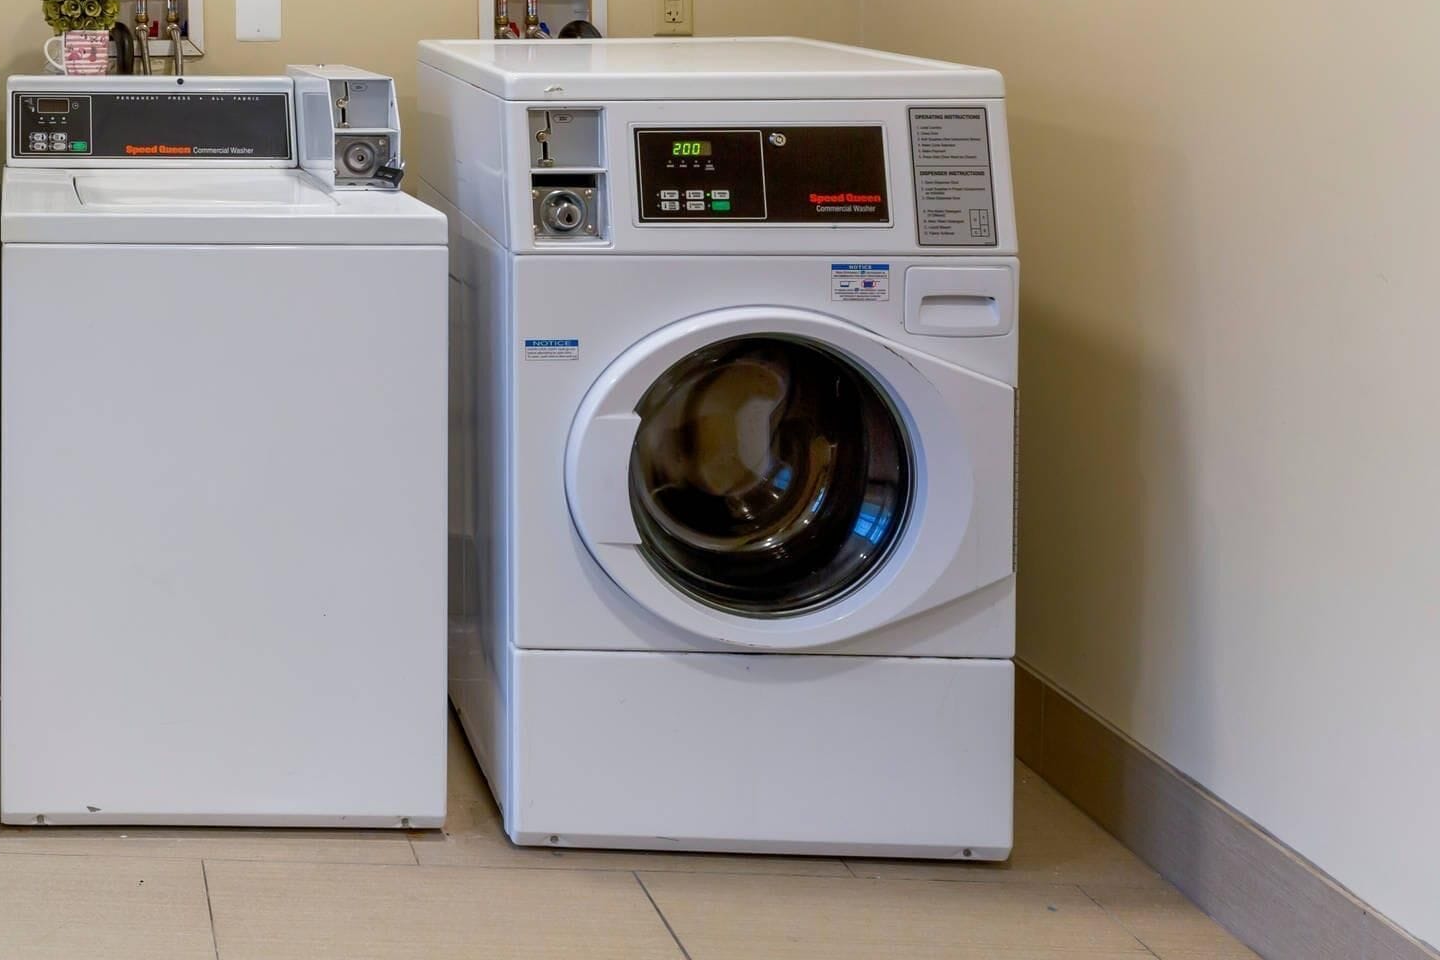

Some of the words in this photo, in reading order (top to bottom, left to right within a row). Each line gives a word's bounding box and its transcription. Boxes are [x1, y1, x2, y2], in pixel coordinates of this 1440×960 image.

[126, 145, 158, 155] Speed
[159, 145, 191, 154] Queen
[193, 146, 229, 154] Commercial
[672, 142, 701, 156] 200
[809, 193, 845, 204] Speed
[846, 193, 881, 202] Queen
